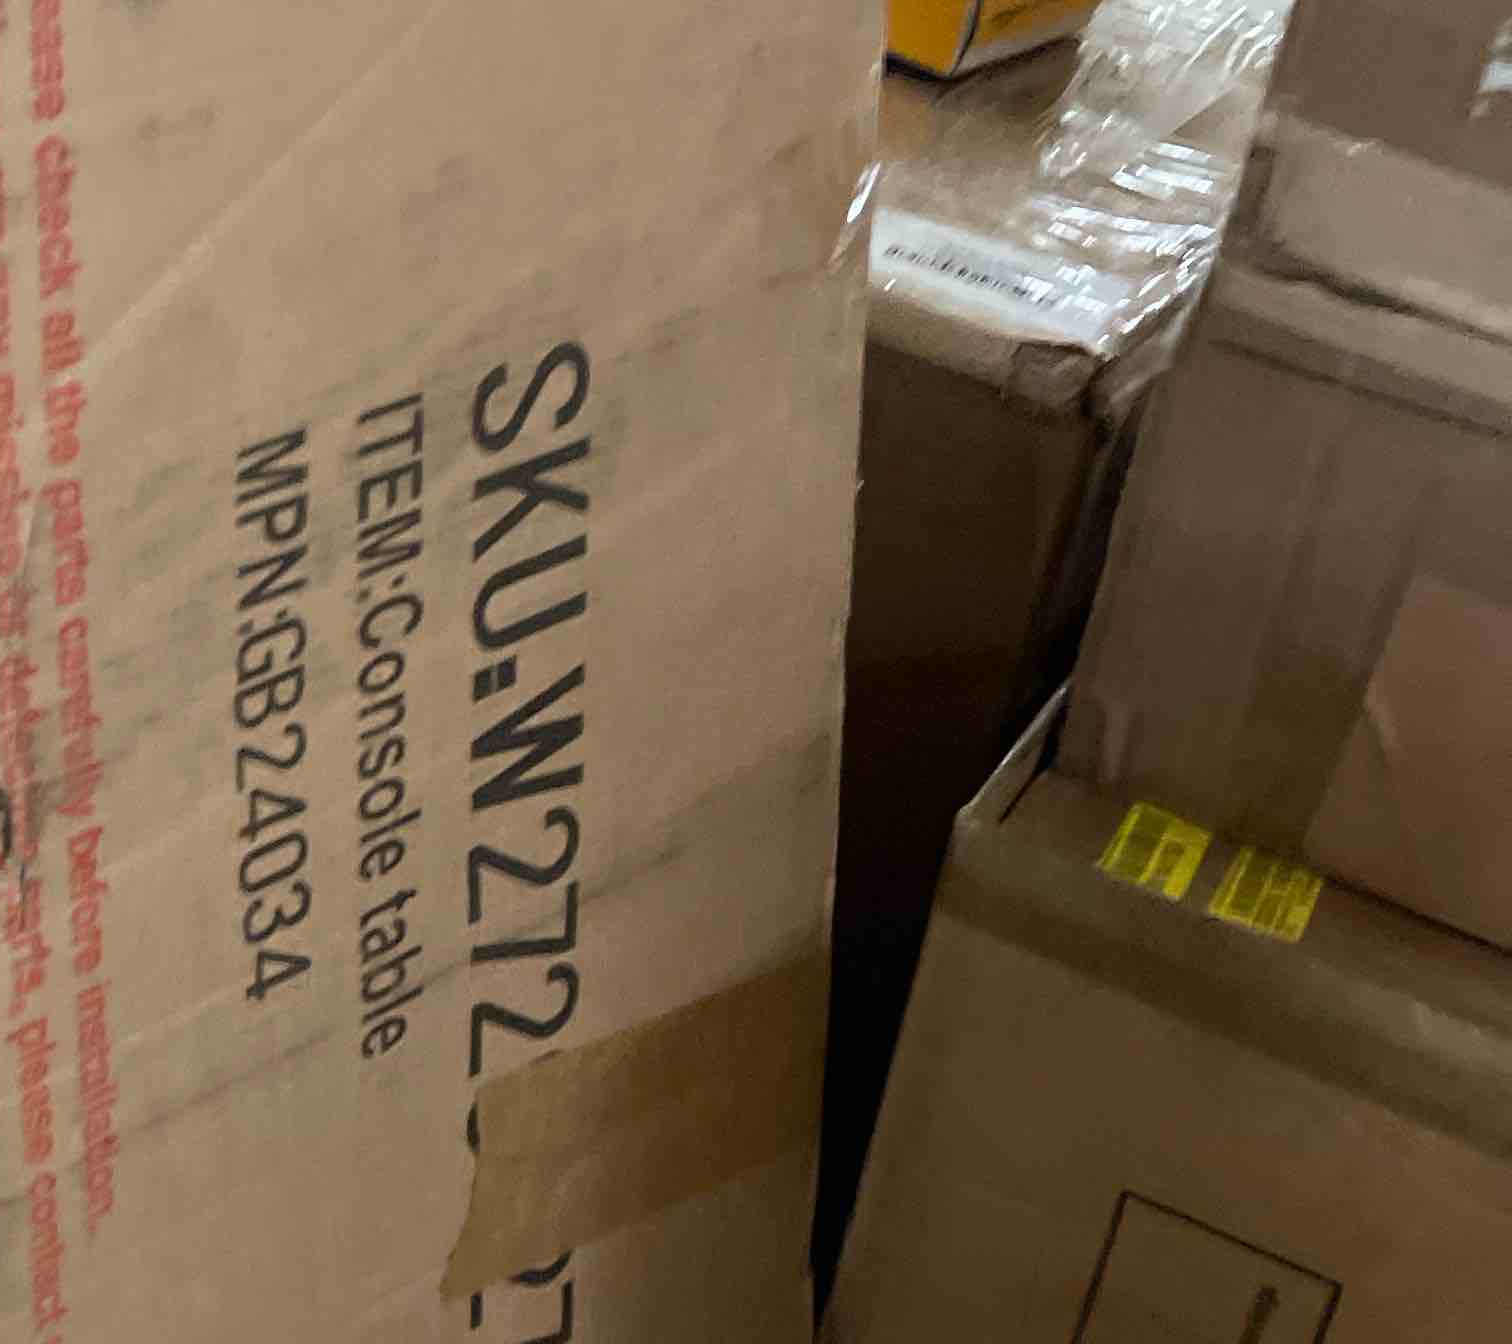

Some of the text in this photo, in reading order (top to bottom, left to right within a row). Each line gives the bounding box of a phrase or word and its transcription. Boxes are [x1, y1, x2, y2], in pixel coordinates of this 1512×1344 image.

[34, 134, 86, 300] check
[40, 311, 87, 374] all
[44, 376, 88, 466] the
[41, 479, 90, 606] parts
[55, 617, 104, 816] carefully
[232, 422, 313, 1003] MPN:GB24034
[67, 823, 109, 974] before
[358, 886, 425, 1061] table
[6, 1016, 56, 1163] please
